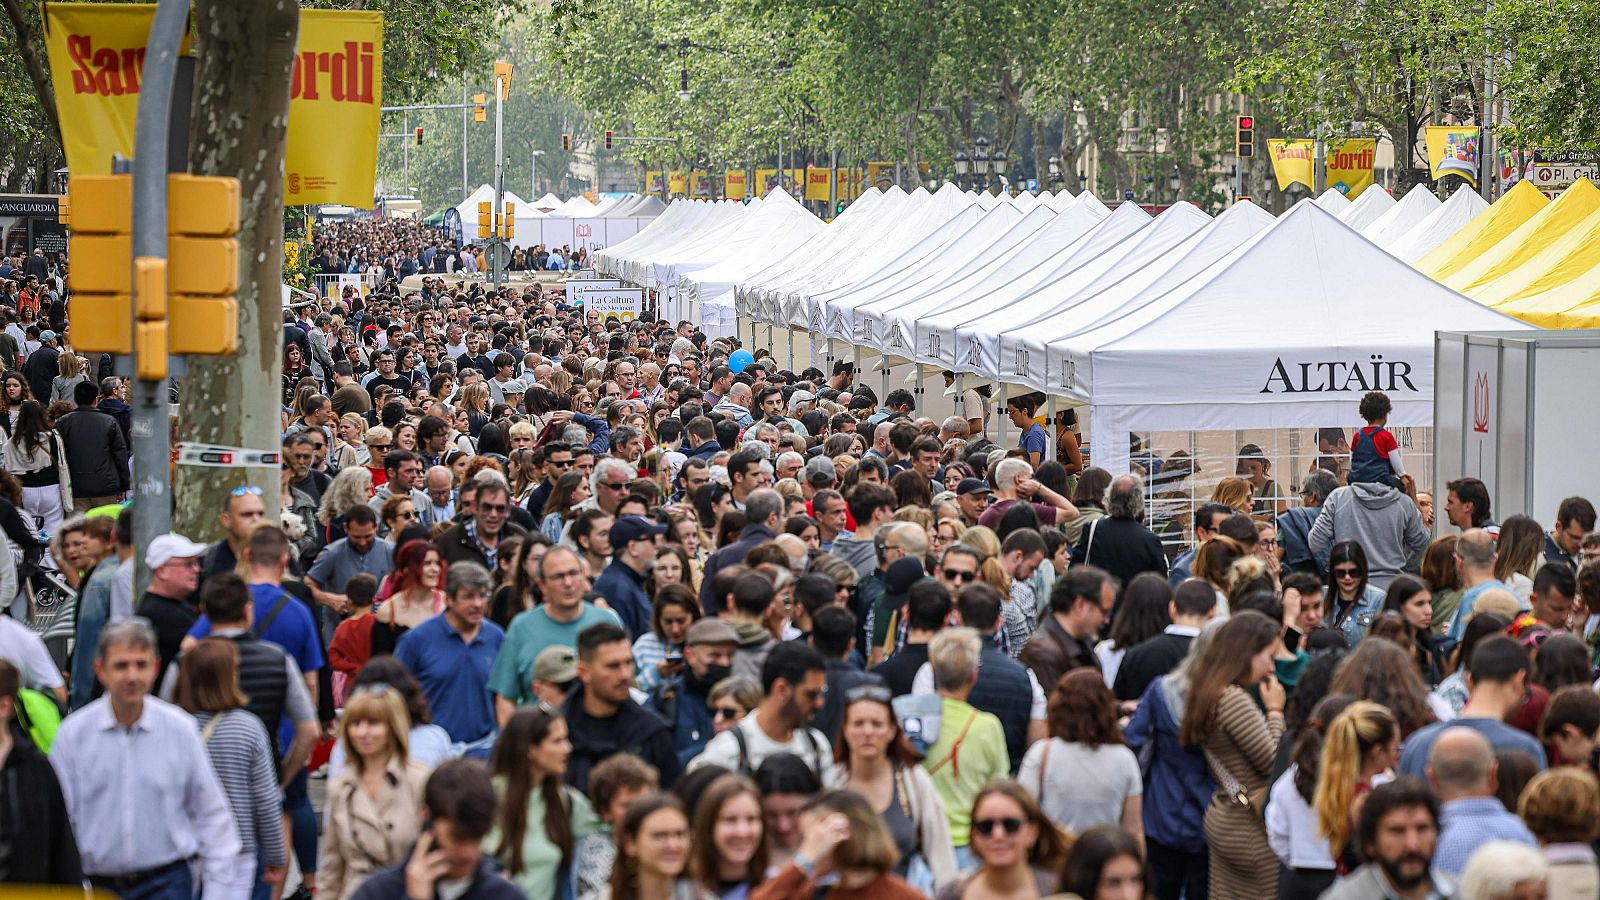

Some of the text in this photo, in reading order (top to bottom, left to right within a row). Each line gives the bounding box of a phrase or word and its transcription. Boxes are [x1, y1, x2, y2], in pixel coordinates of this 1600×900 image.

[67, 34, 146, 97] San
[291, 41, 374, 104] rdi
[1329, 148, 1373, 170] Jordi
[809, 172, 828, 184] Sant
[1553, 168, 1569, 180] Pl.
[591, 295, 602, 304] La
[603, 295, 635, 304] Cultura
[1259, 354, 1419, 394] ALTAÏR
